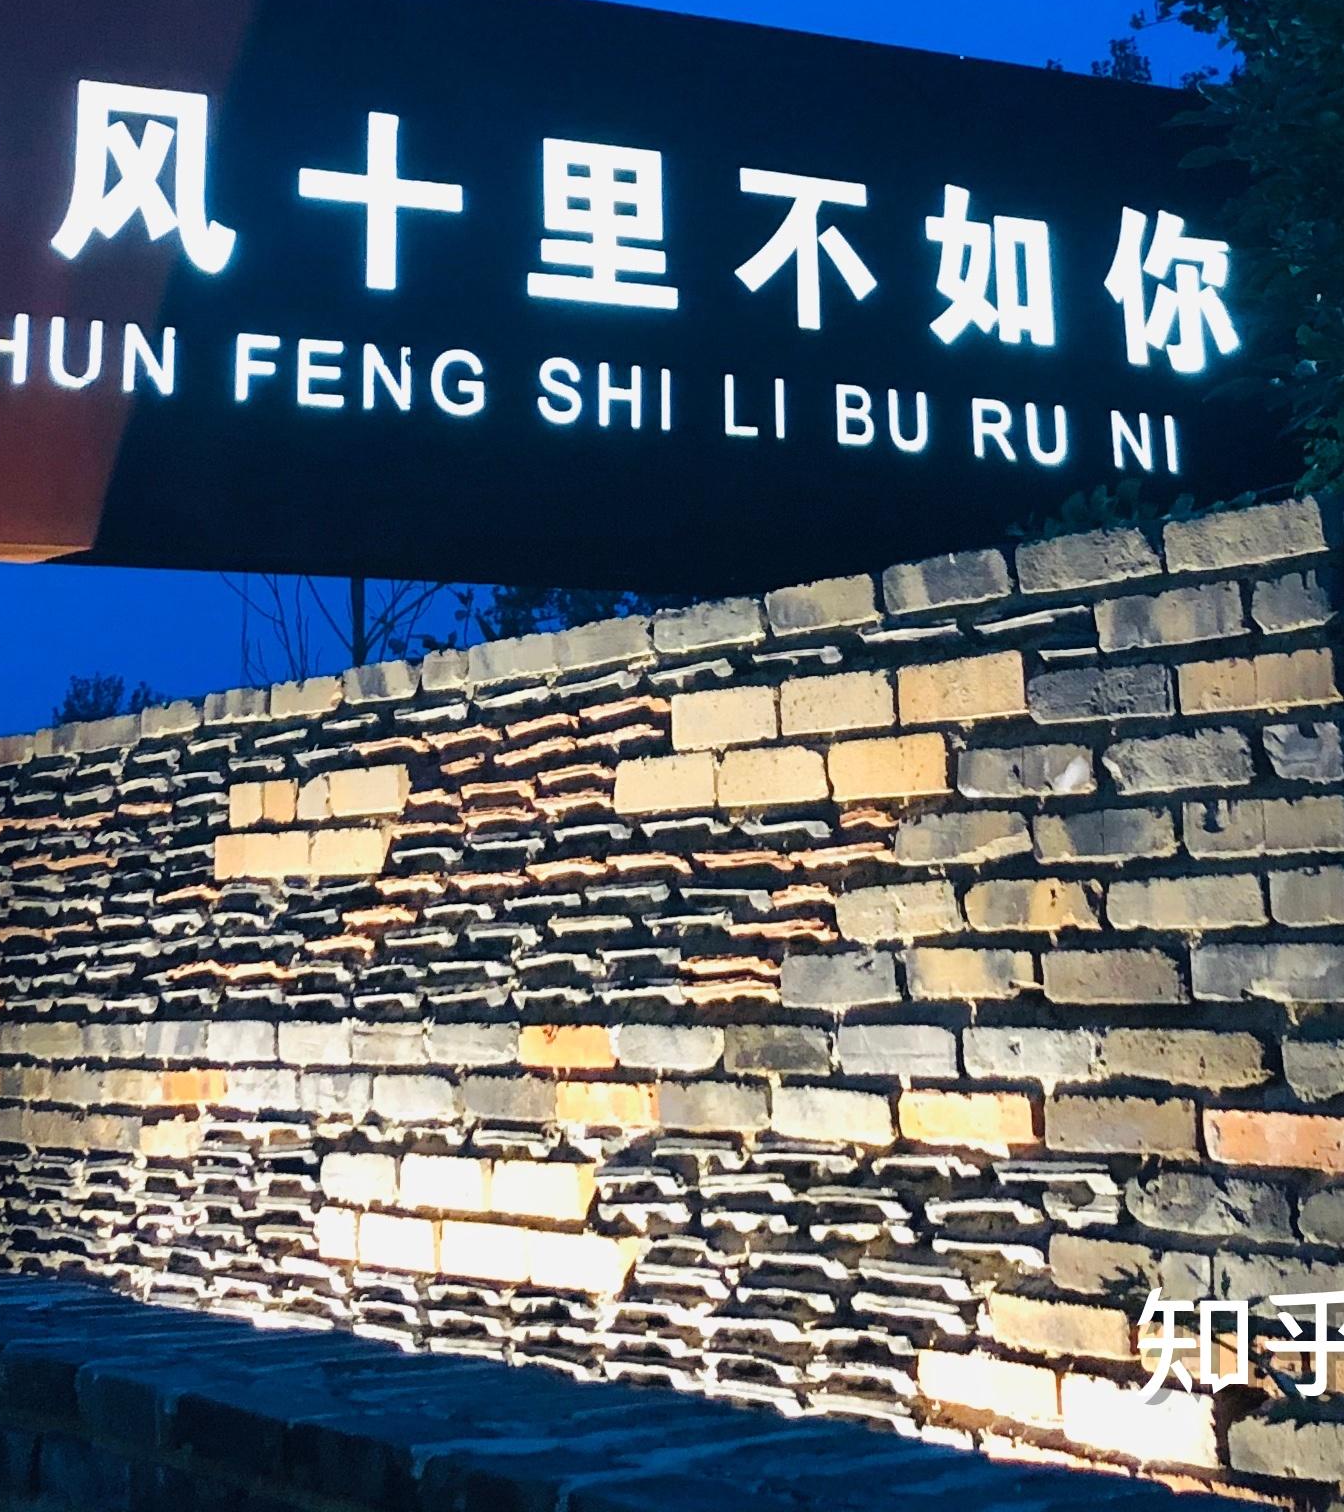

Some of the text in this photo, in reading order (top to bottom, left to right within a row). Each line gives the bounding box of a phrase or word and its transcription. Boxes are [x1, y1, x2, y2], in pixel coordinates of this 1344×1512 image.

[234, 331, 486, 417] FENG
[536, 356, 672, 432] SHI
[723, 373, 786, 440] LI
[834, 382, 929, 453] BU
[970, 396, 1068, 466] RU
[1109, 409, 1179, 474] NI
